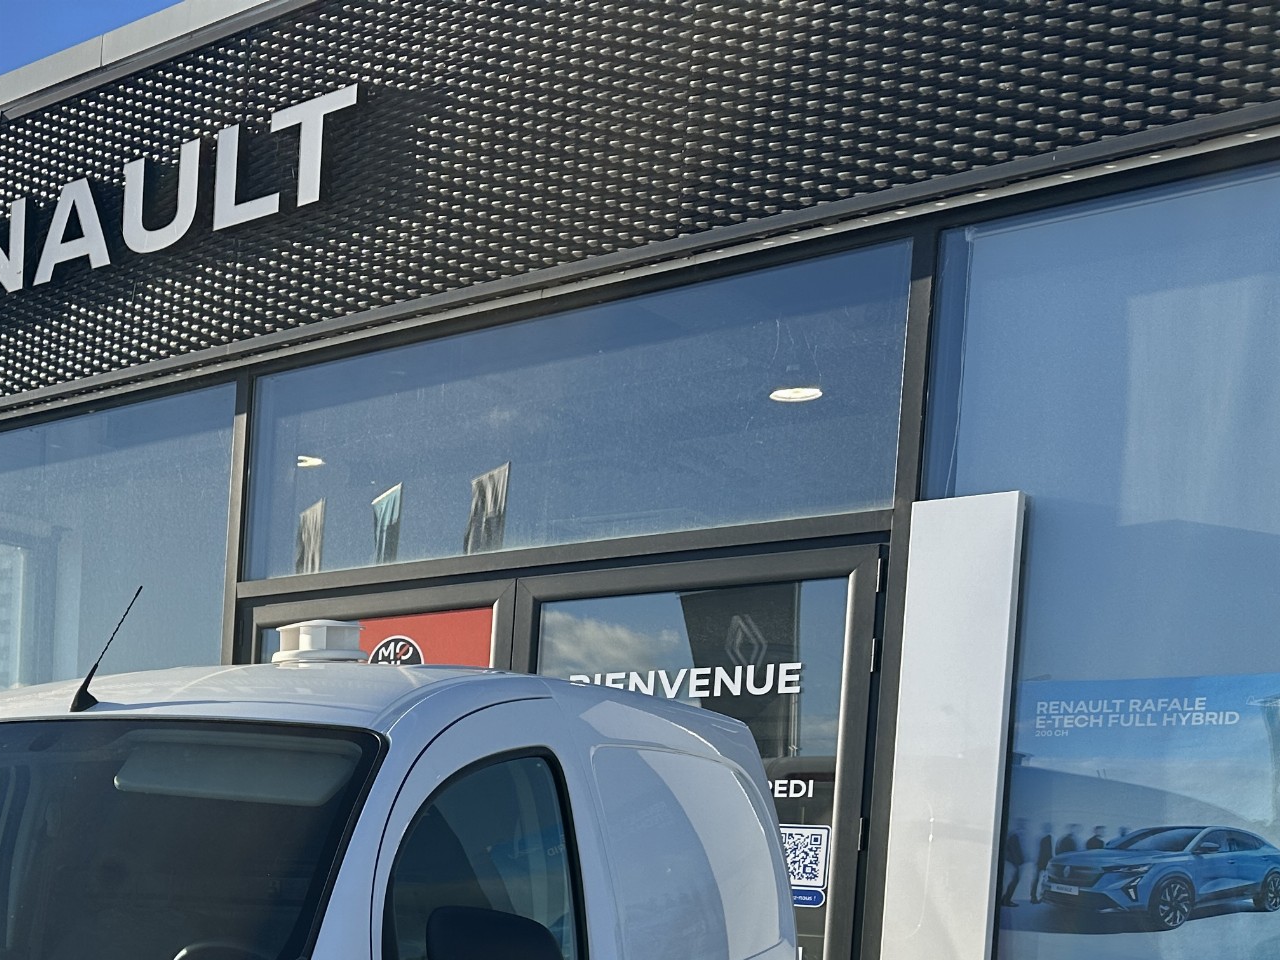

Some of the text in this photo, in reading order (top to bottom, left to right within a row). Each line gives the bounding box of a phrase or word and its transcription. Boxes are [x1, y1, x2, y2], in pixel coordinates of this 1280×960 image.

[570, 662, 801, 698] ENVENUE
[1036, 697, 1207, 715] RENAULT RAFALE
[1035, 711, 1241, 729] E-TECH FULL HYBRID
[1054, 729, 1069, 737] CH
[767, 779, 814, 798] EDI
